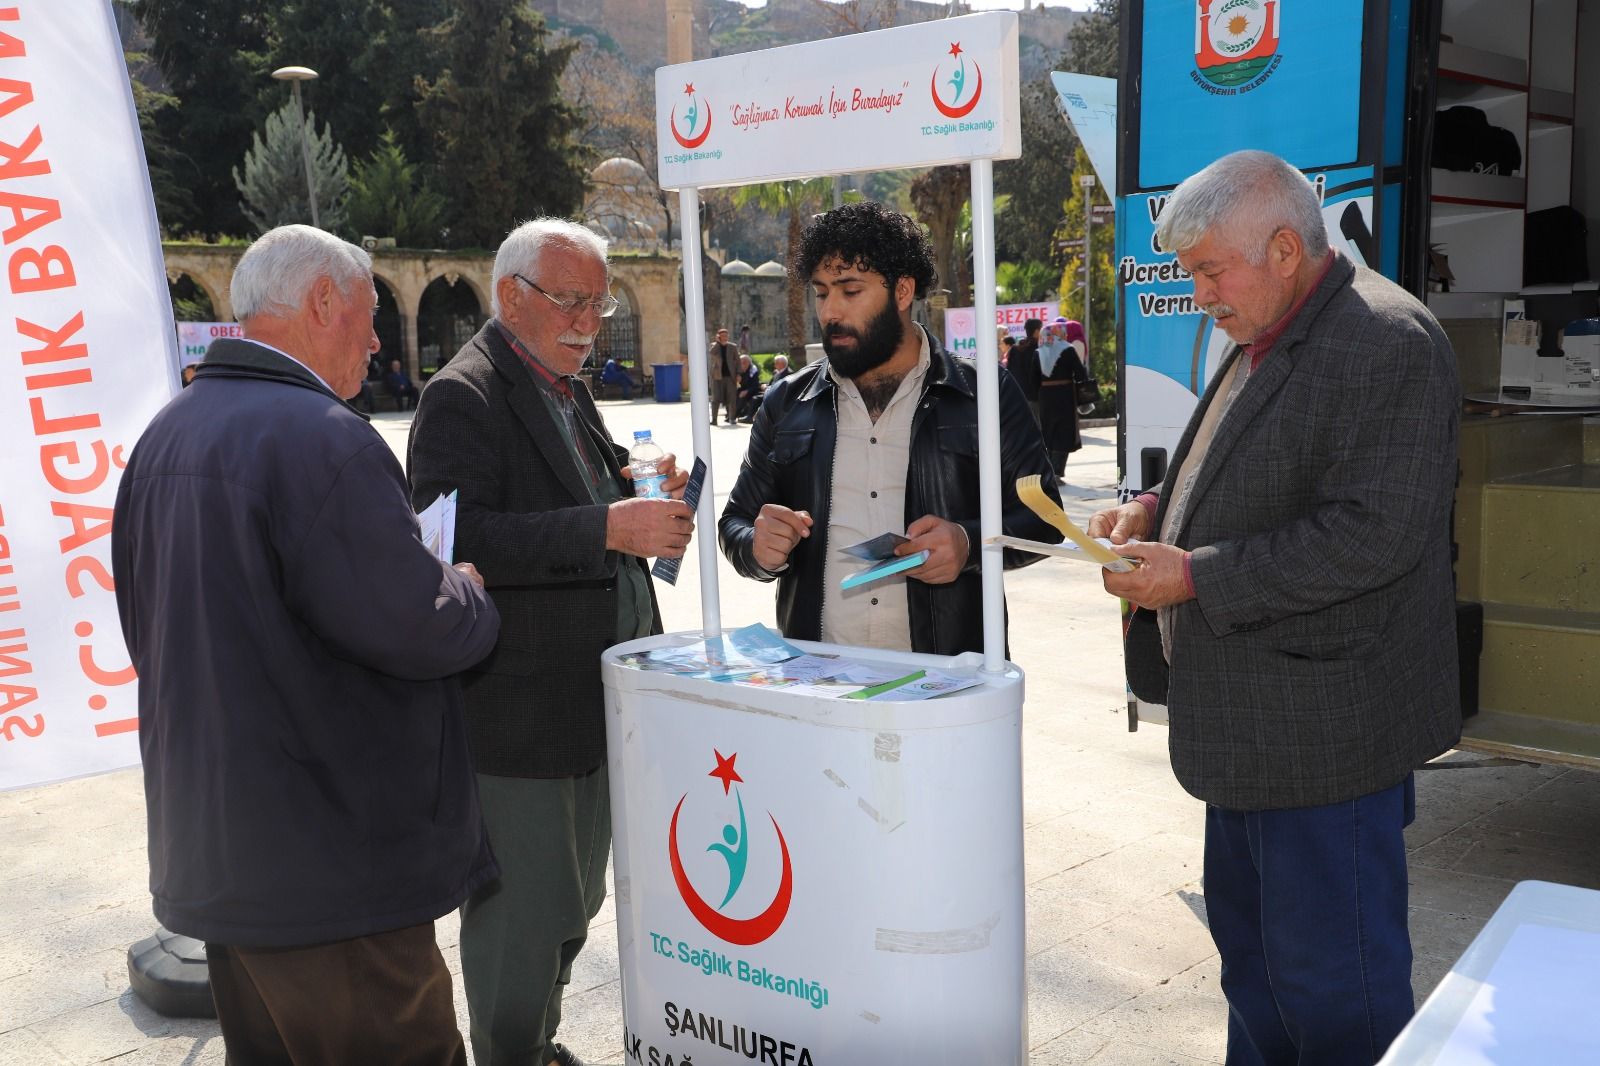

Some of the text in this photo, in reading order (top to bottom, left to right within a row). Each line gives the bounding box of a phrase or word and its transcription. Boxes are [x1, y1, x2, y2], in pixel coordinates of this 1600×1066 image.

[784, 95, 825, 119] Korumak
[828, 85, 847, 119] İçin
[933, 124, 957, 135] Sağlık
[959, 119, 995, 131] Bakanlığı
[650, 932, 829, 1009] T.C. Sağlık Bakanlığı
[664, 1001, 814, 1066] ŞANLIURFA
